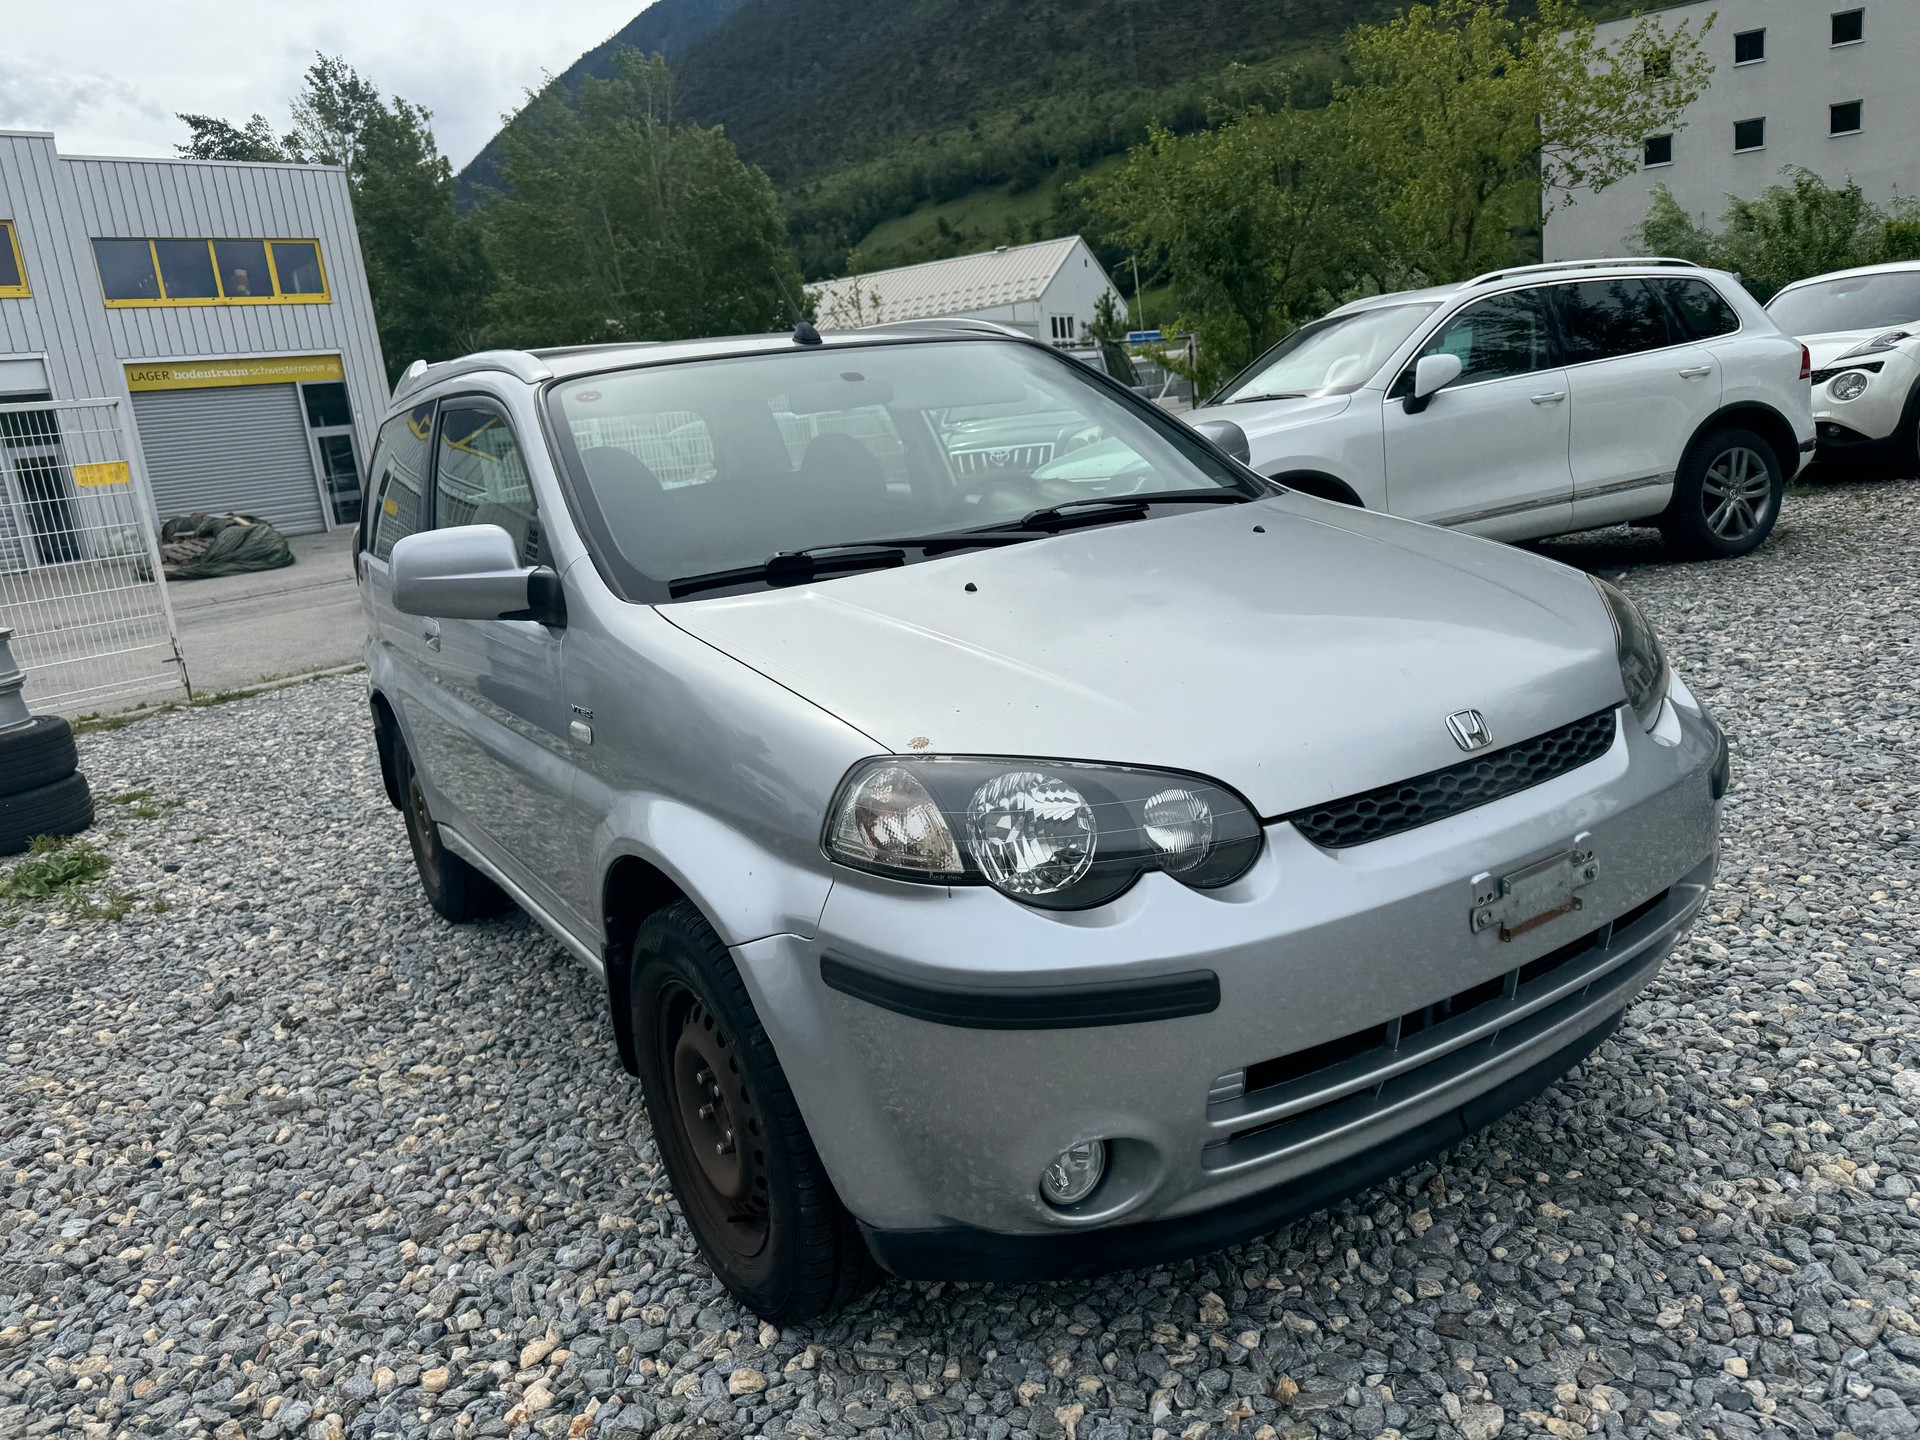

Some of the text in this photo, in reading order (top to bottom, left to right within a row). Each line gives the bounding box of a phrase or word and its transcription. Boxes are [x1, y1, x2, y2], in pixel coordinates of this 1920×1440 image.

[130, 363, 340, 382] LAGER bodentraum schwestermann ag
[571, 703, 594, 719] VTEC
